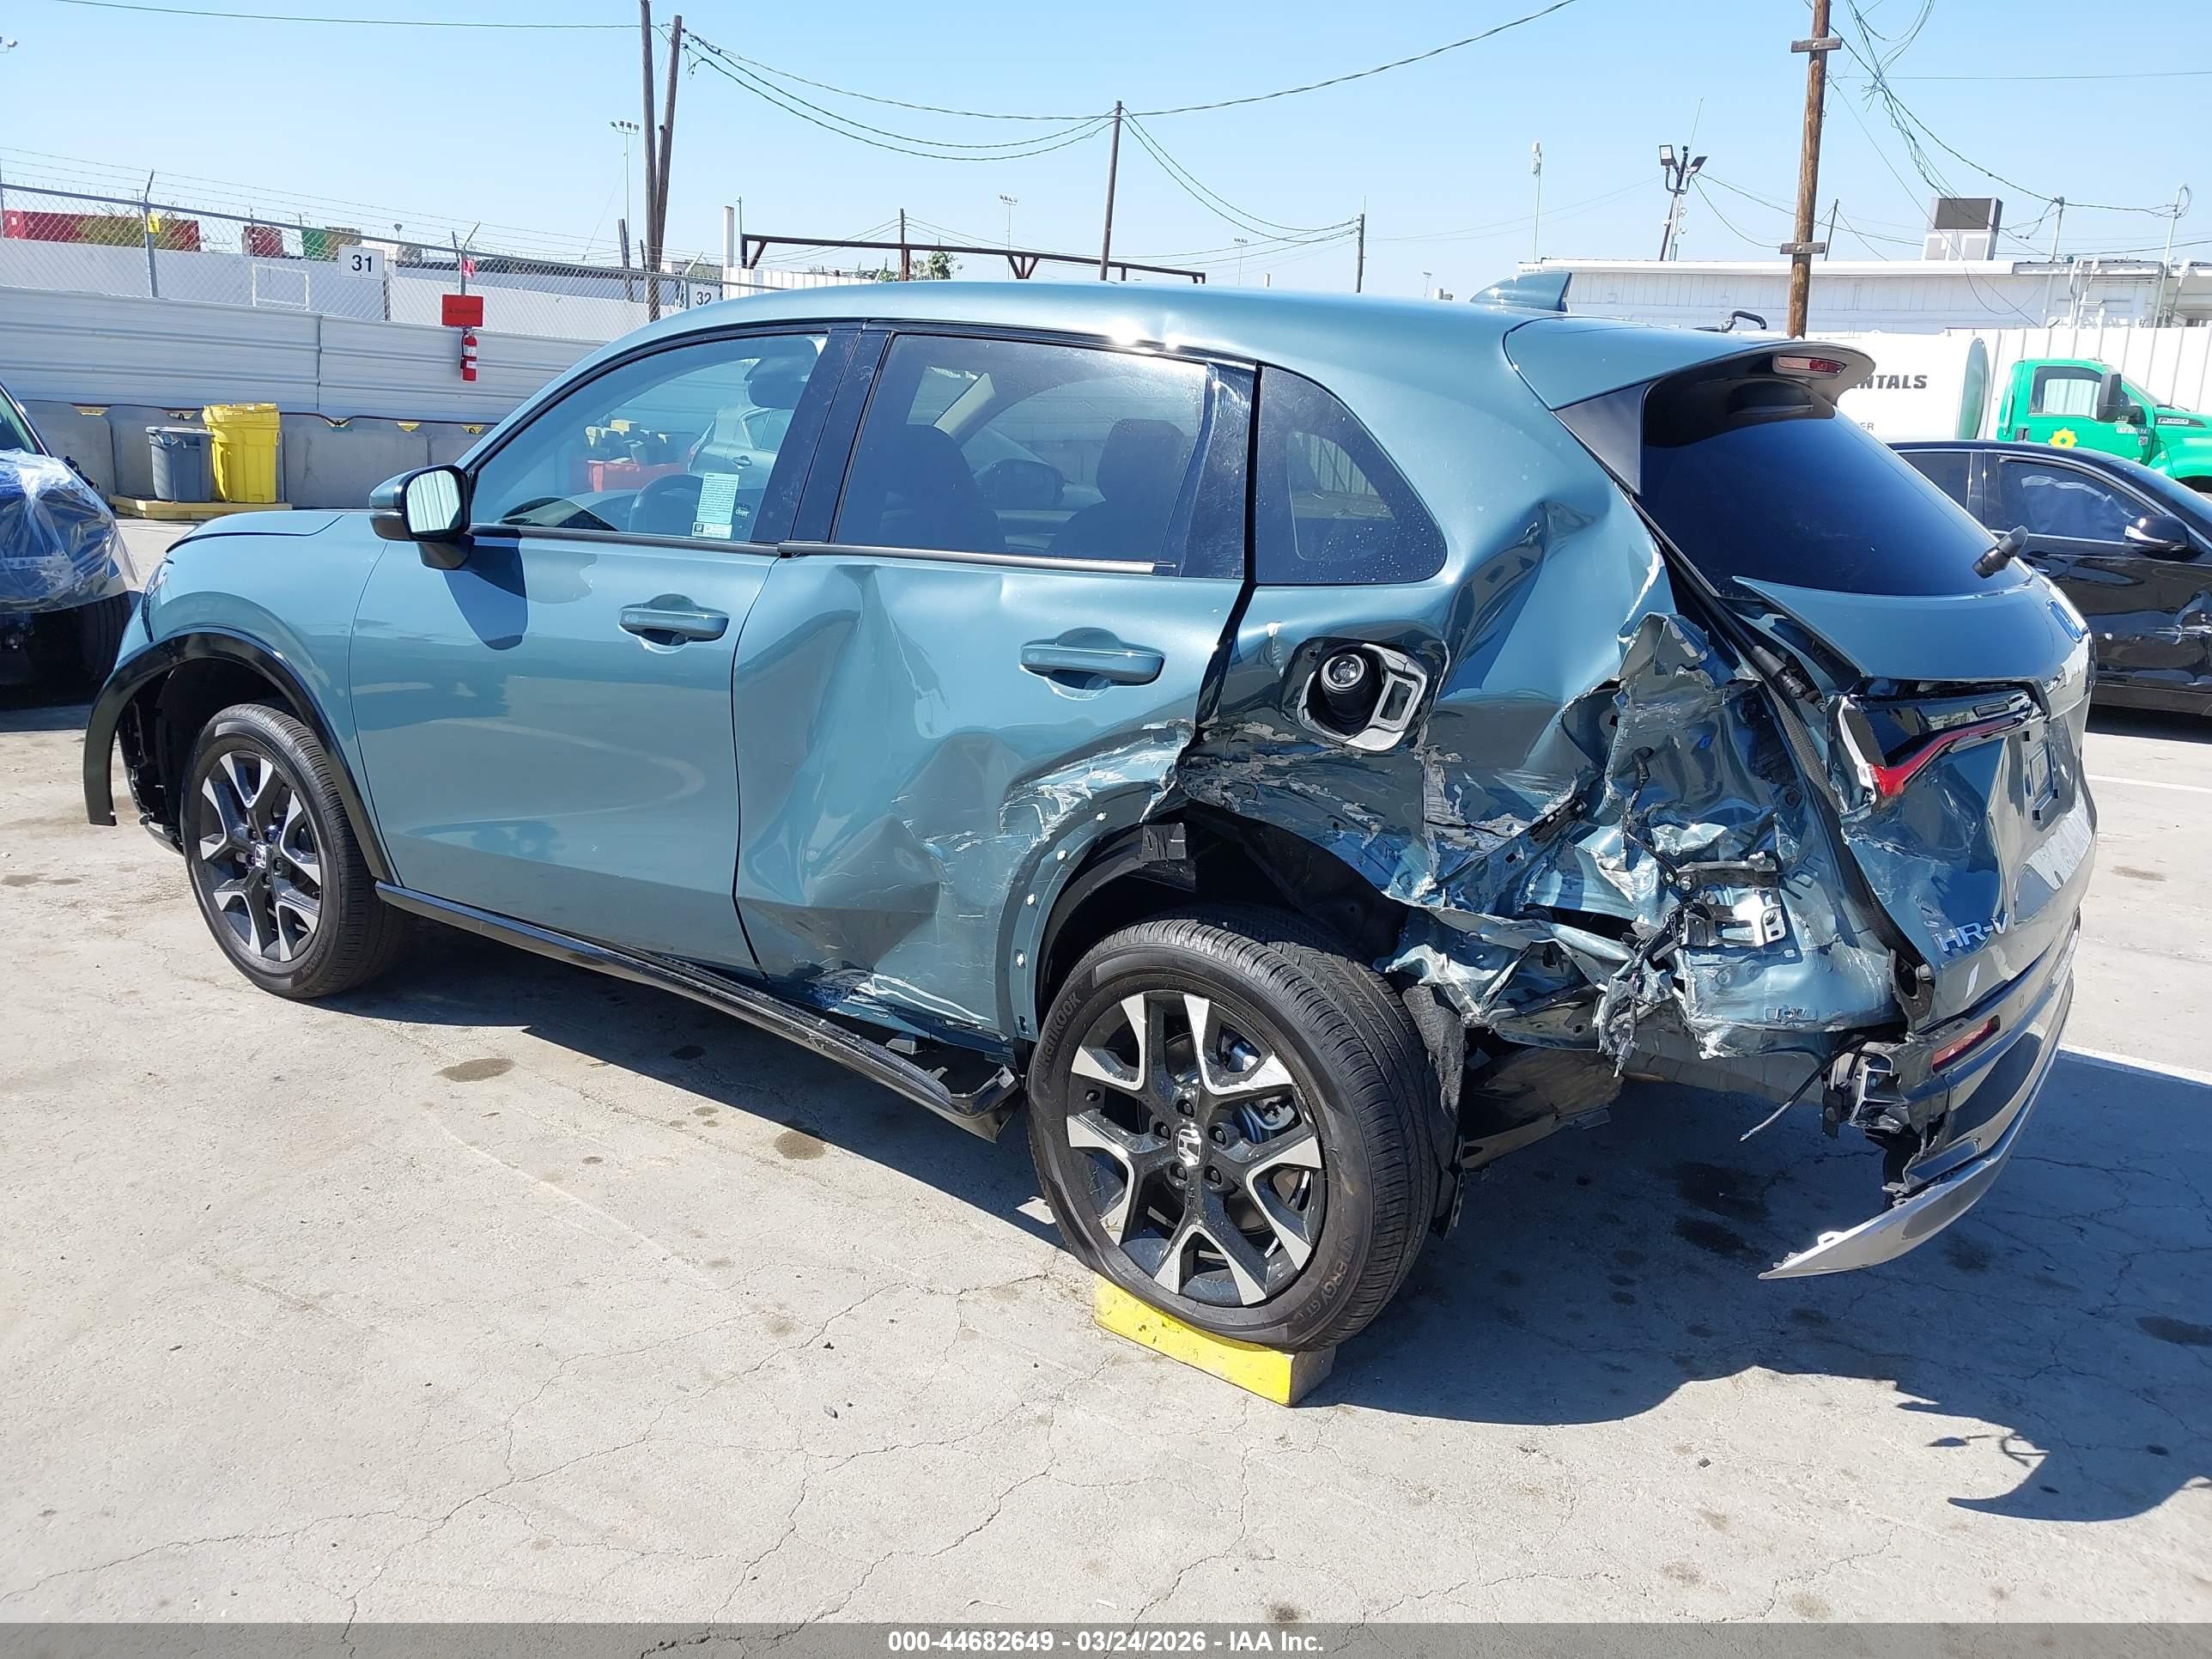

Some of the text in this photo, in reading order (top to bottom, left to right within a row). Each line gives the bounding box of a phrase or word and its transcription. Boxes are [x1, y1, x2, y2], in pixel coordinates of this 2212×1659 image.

[350, 254, 373, 273] 31
[696, 291, 712, 306] 32
[1855, 374, 1929, 390] NTALS
[1932, 912, 2008, 952] HR-V
